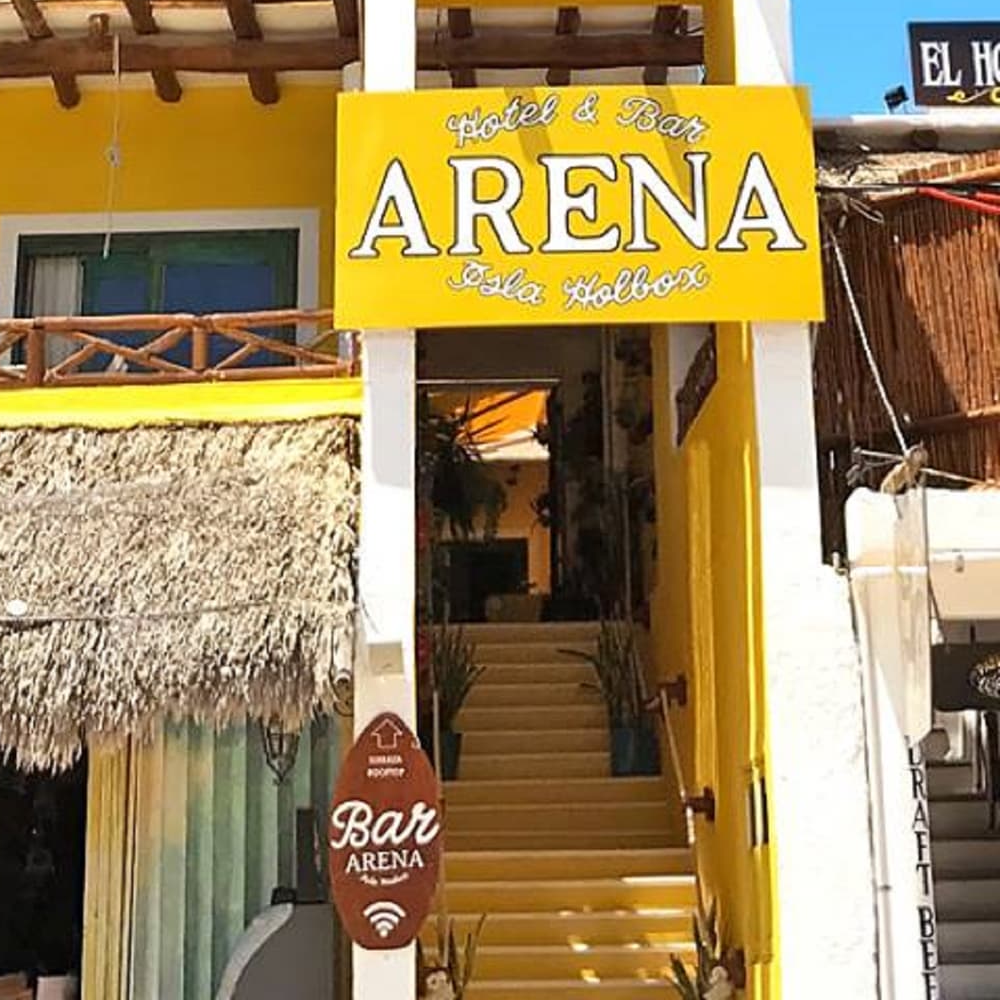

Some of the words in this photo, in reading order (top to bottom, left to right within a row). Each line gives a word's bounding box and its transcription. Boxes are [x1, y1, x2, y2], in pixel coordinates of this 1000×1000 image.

[919, 41, 962, 87] EL
[447, 93, 561, 148] Hotel
[573, 91, 599, 124] &
[616, 96, 710, 144] Bar
[346, 151, 808, 259] ARENA
[447, 259, 545, 305] Isla
[562, 262, 708, 311] Holbox
[330, 800, 440, 849] Bar
[345, 849, 424, 874] ARENA
